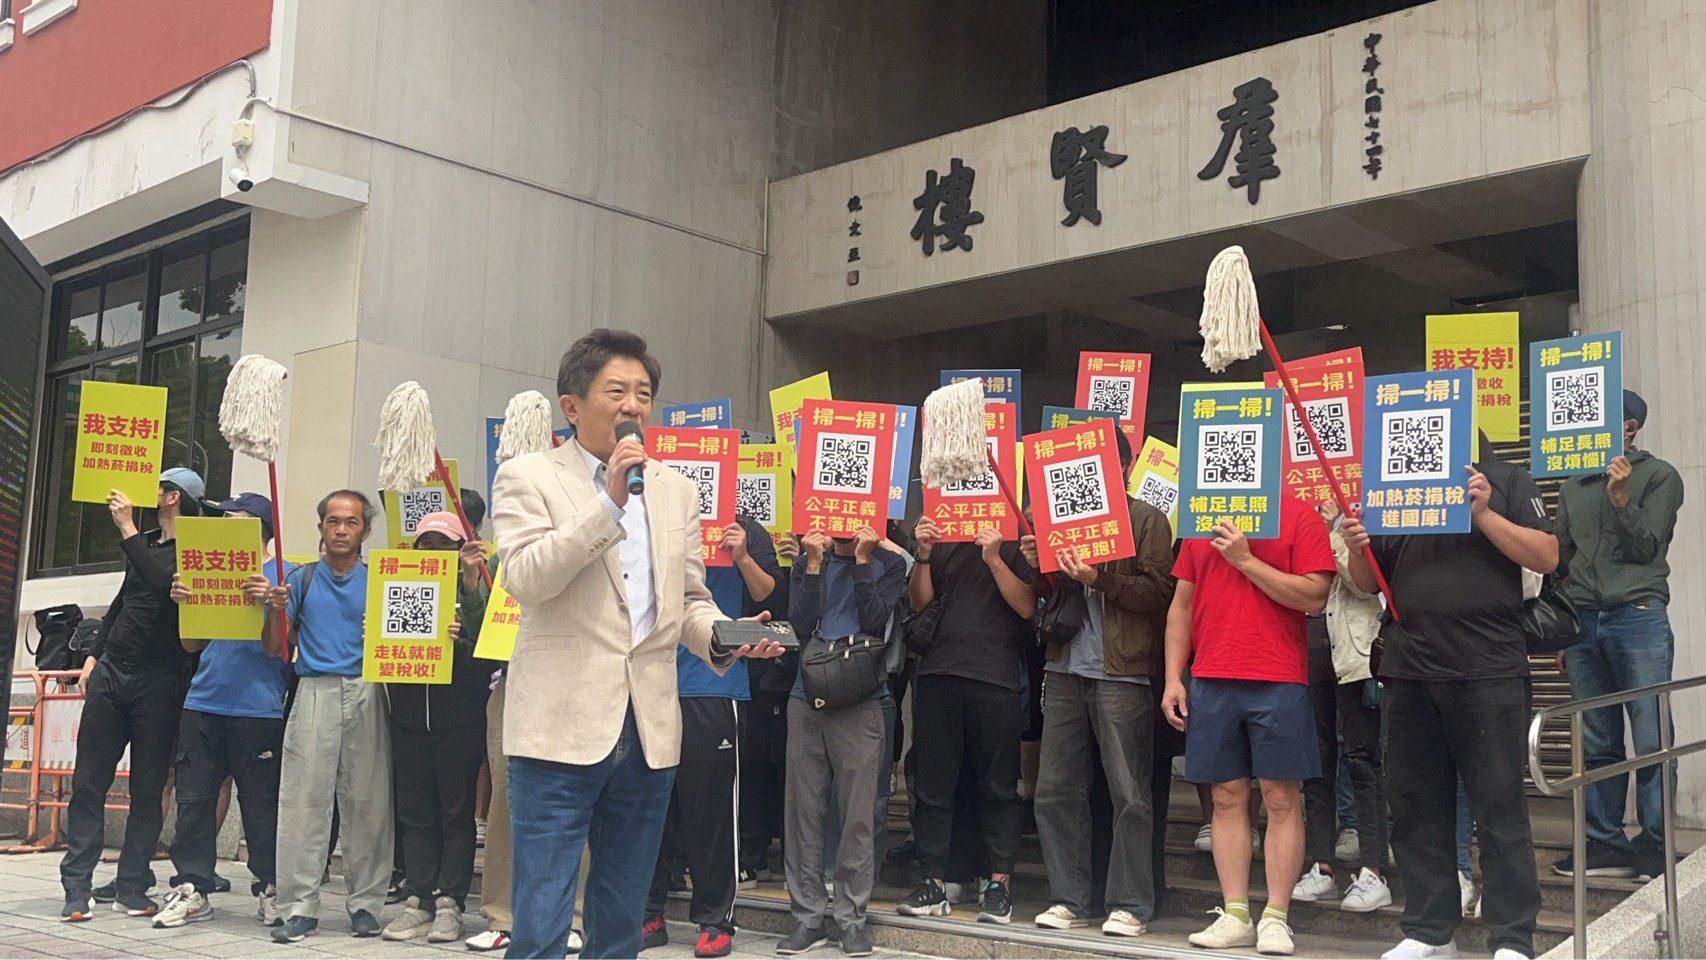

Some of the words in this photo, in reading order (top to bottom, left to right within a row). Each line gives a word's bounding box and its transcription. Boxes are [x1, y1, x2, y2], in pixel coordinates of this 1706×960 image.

[1431, 346, 1514, 370] 我支持!
[1540, 340, 1612, 367] 掃一掃!
[1087, 357, 1143, 373] 掃一掃!
[1376, 379, 1461, 407] 掃一掃!
[670, 405, 723, 427] 掃一掃!
[813, 407, 886, 430] 掃一掃!
[1193, 397, 1272, 419] 掃一掃!
[83, 413, 160, 440] 我支持!
[90, 441, 148, 458] 即刻徵收
[656, 434, 729, 456] 掃一掃!
[1034, 428, 1107, 461] 掃一掃!
[1540, 432, 1612, 453] 補足長照
[1546, 451, 1606, 472] 沒煩惱!
[804, 496, 878, 517] 公平正義
[1189, 496, 1268, 513] 補足長照
[1366, 486, 1465, 508] 加熱菸捐稅
[934, 502, 1006, 518] 公平正義
[1381, 508, 1447, 528] 進國庫!
[1047, 519, 1120, 547] 公平正義
[181, 549, 257, 571] 我支持!
[379, 557, 448, 576] 掃一掃!
[374, 644, 443, 660] 走私就能
[379, 662, 436, 677] 變稅收!
